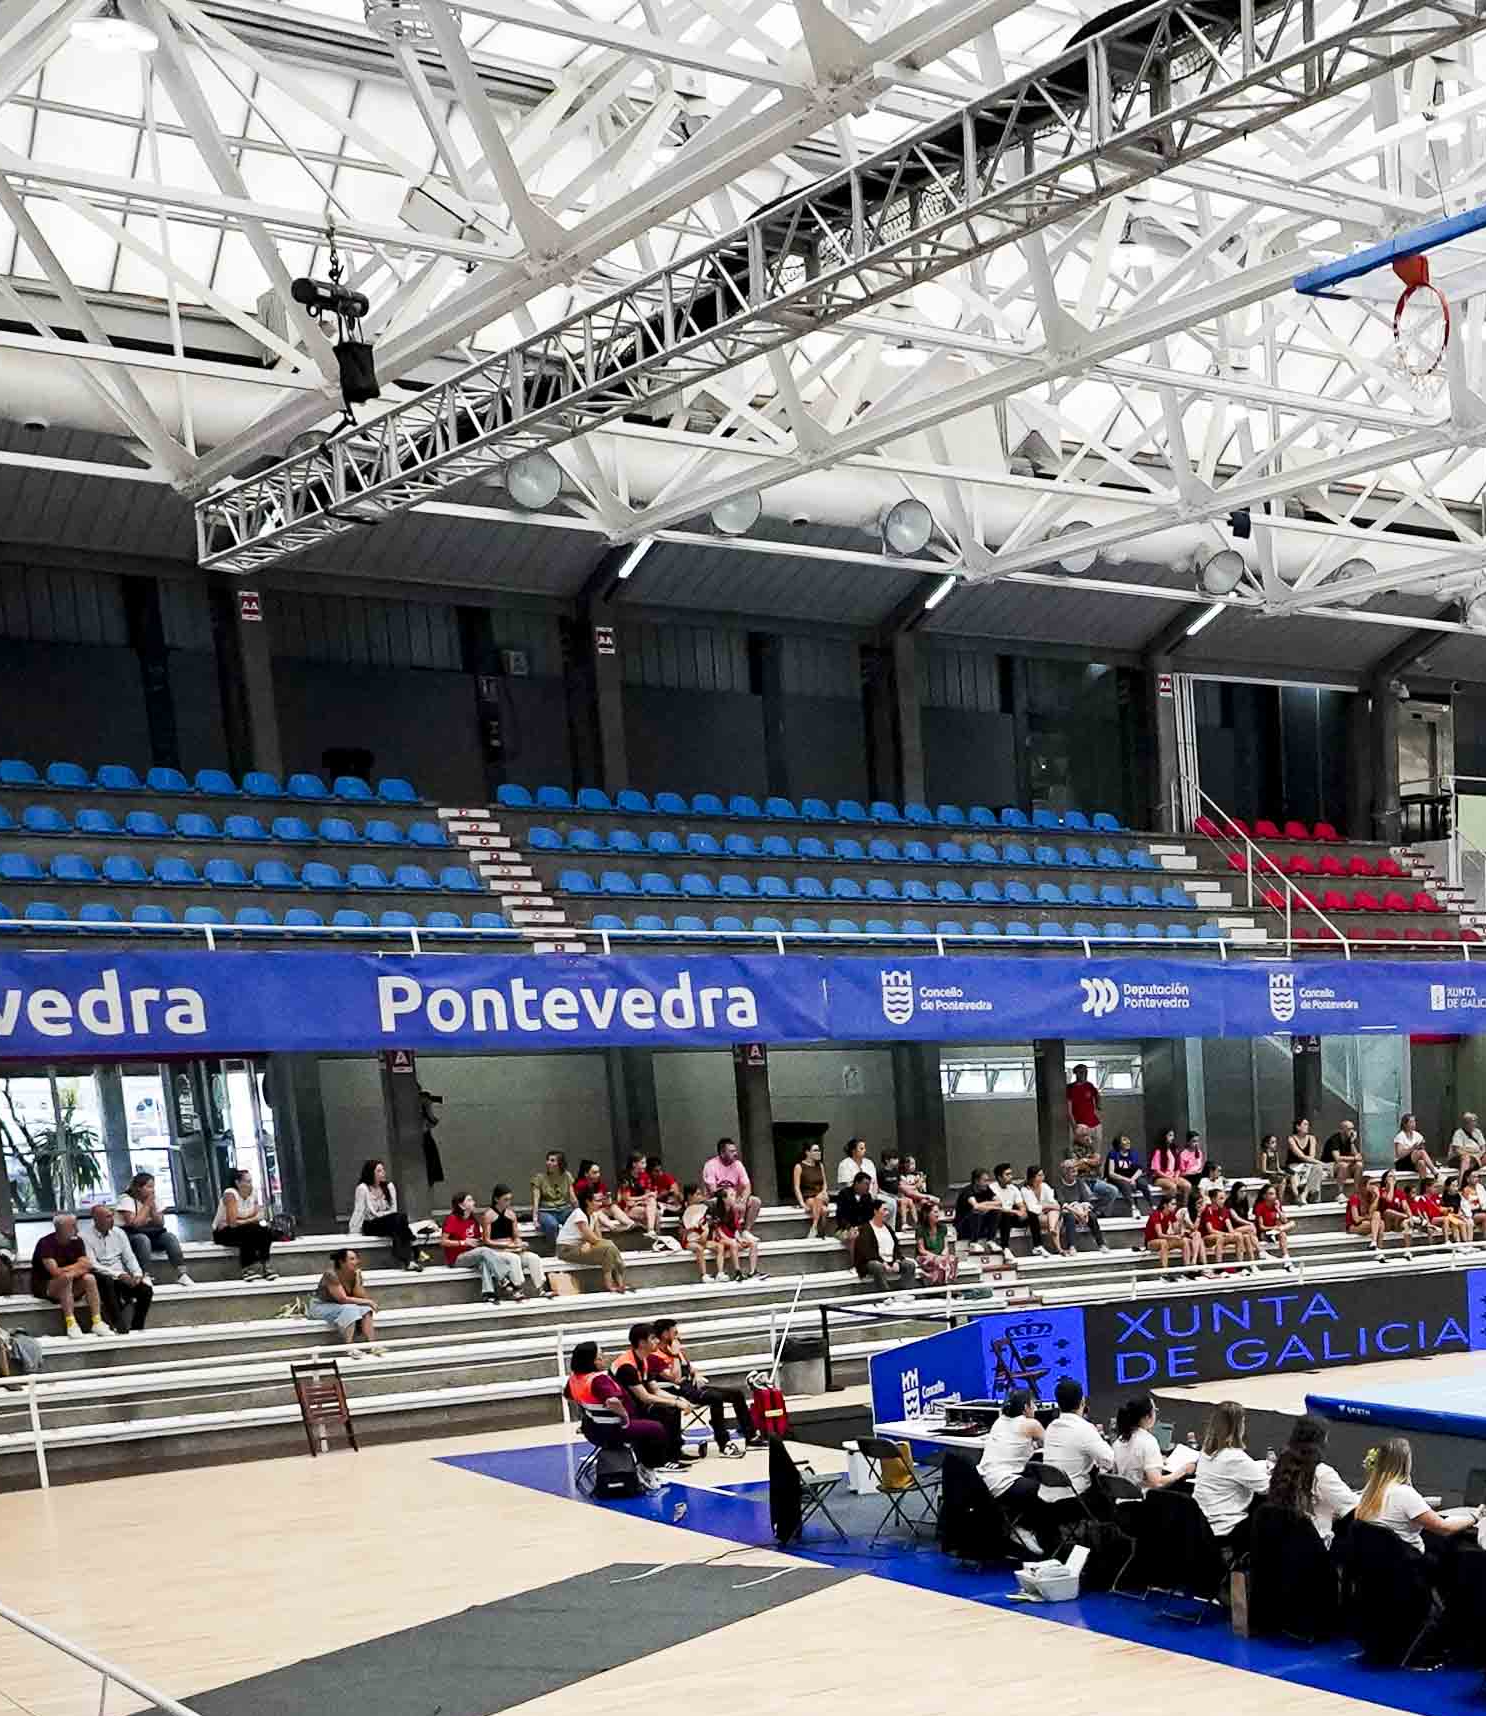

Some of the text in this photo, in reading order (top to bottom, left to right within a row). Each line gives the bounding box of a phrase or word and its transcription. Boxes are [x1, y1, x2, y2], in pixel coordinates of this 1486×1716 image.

[919, 986, 964, 998] Concello
[1122, 982, 1190, 997] Deputación
[1298, 987, 1336, 999] Concello
[1446, 987, 1477, 998] XUNTA
[376, 969, 760, 1033] Pontevedra
[920, 999, 993, 1012] de Pontevedra
[1123, 996, 1191, 1010] Pontevedra
[1300, 998, 1359, 1010] de Pontevedra
[1447, 999, 1460, 1009] DE
[1116, 1291, 1339, 1344] XUNTA
[1116, 1316, 1471, 1385] DE GALICIA
